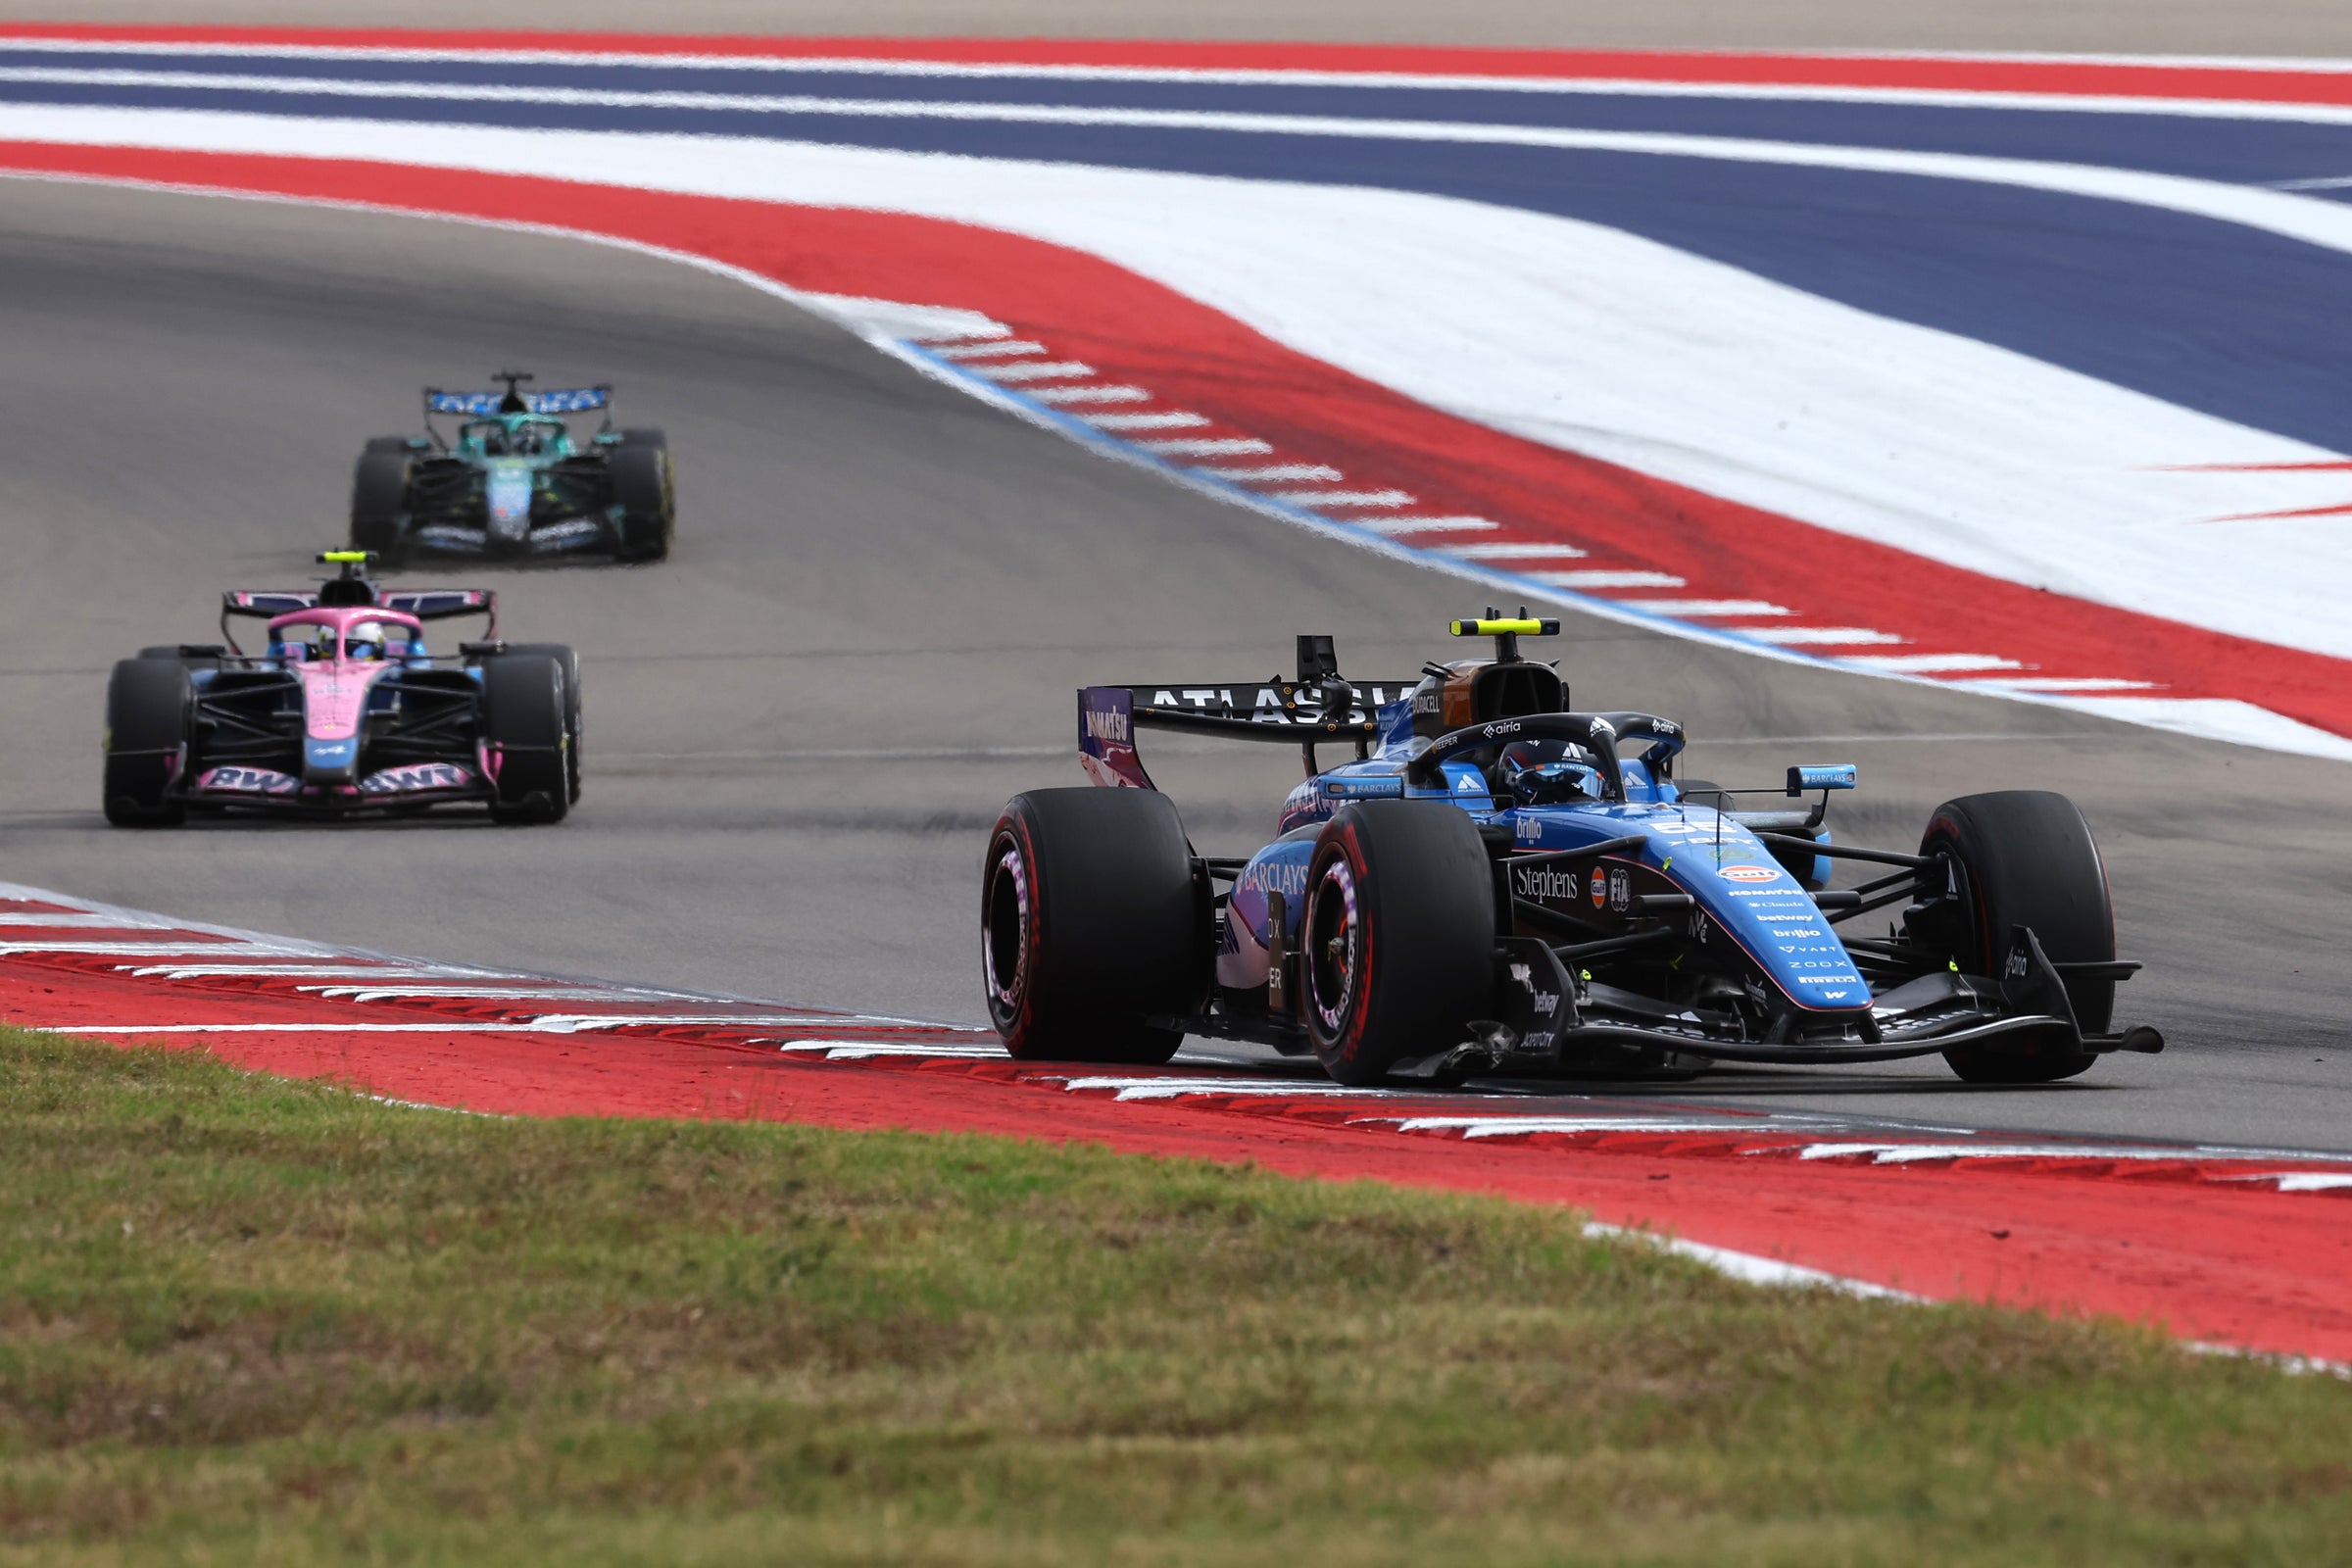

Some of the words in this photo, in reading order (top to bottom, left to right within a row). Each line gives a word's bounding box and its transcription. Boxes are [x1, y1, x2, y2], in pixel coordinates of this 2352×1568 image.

[1412, 695, 1441, 714] DURACELL
[1495, 721, 1521, 735] airia
[1810, 773, 1846, 783] BARCLAYS
[1357, 783, 1401, 794] BARCLAYS
[1244, 862, 1309, 895] BARCLAYS
[1517, 863, 1578, 905] Stephens
[1728, 888, 1803, 897] KOMATSU
[1756, 913, 1813, 922] betway
[1788, 960, 1848, 969] ZOOX
[1797, 975, 1858, 984] PIRELLI
